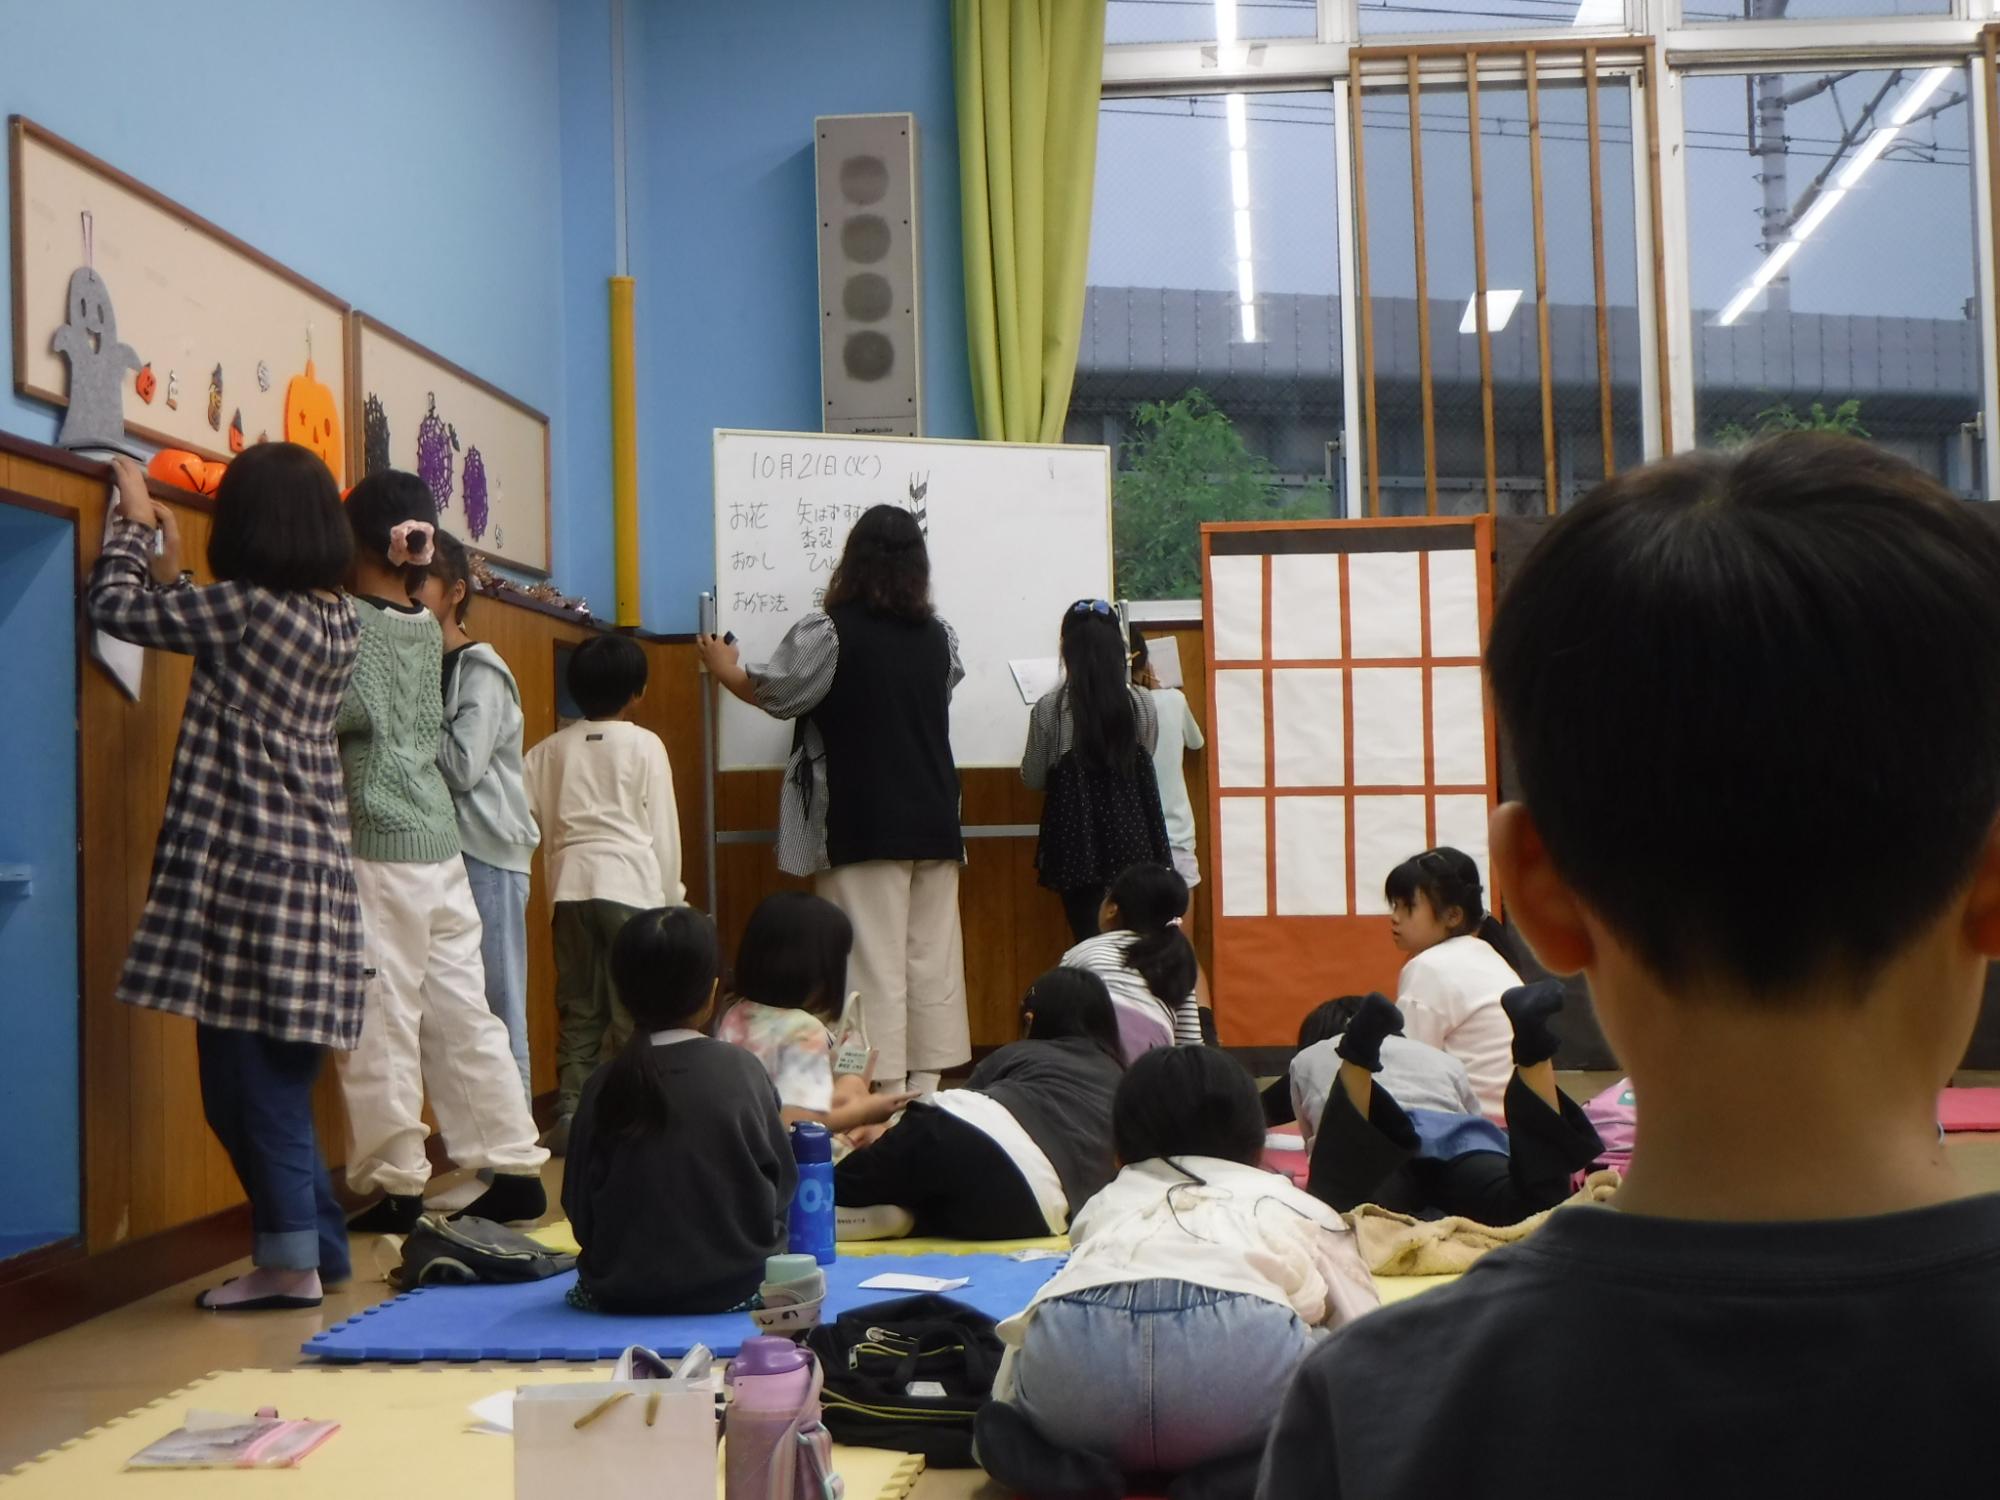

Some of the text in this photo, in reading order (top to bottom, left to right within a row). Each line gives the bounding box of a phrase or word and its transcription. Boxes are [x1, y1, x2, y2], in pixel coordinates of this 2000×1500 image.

[729, 497, 869, 530] お花 矢はずすす
[731, 551, 776, 571] おかし
[733, 591, 789, 614] お作法
